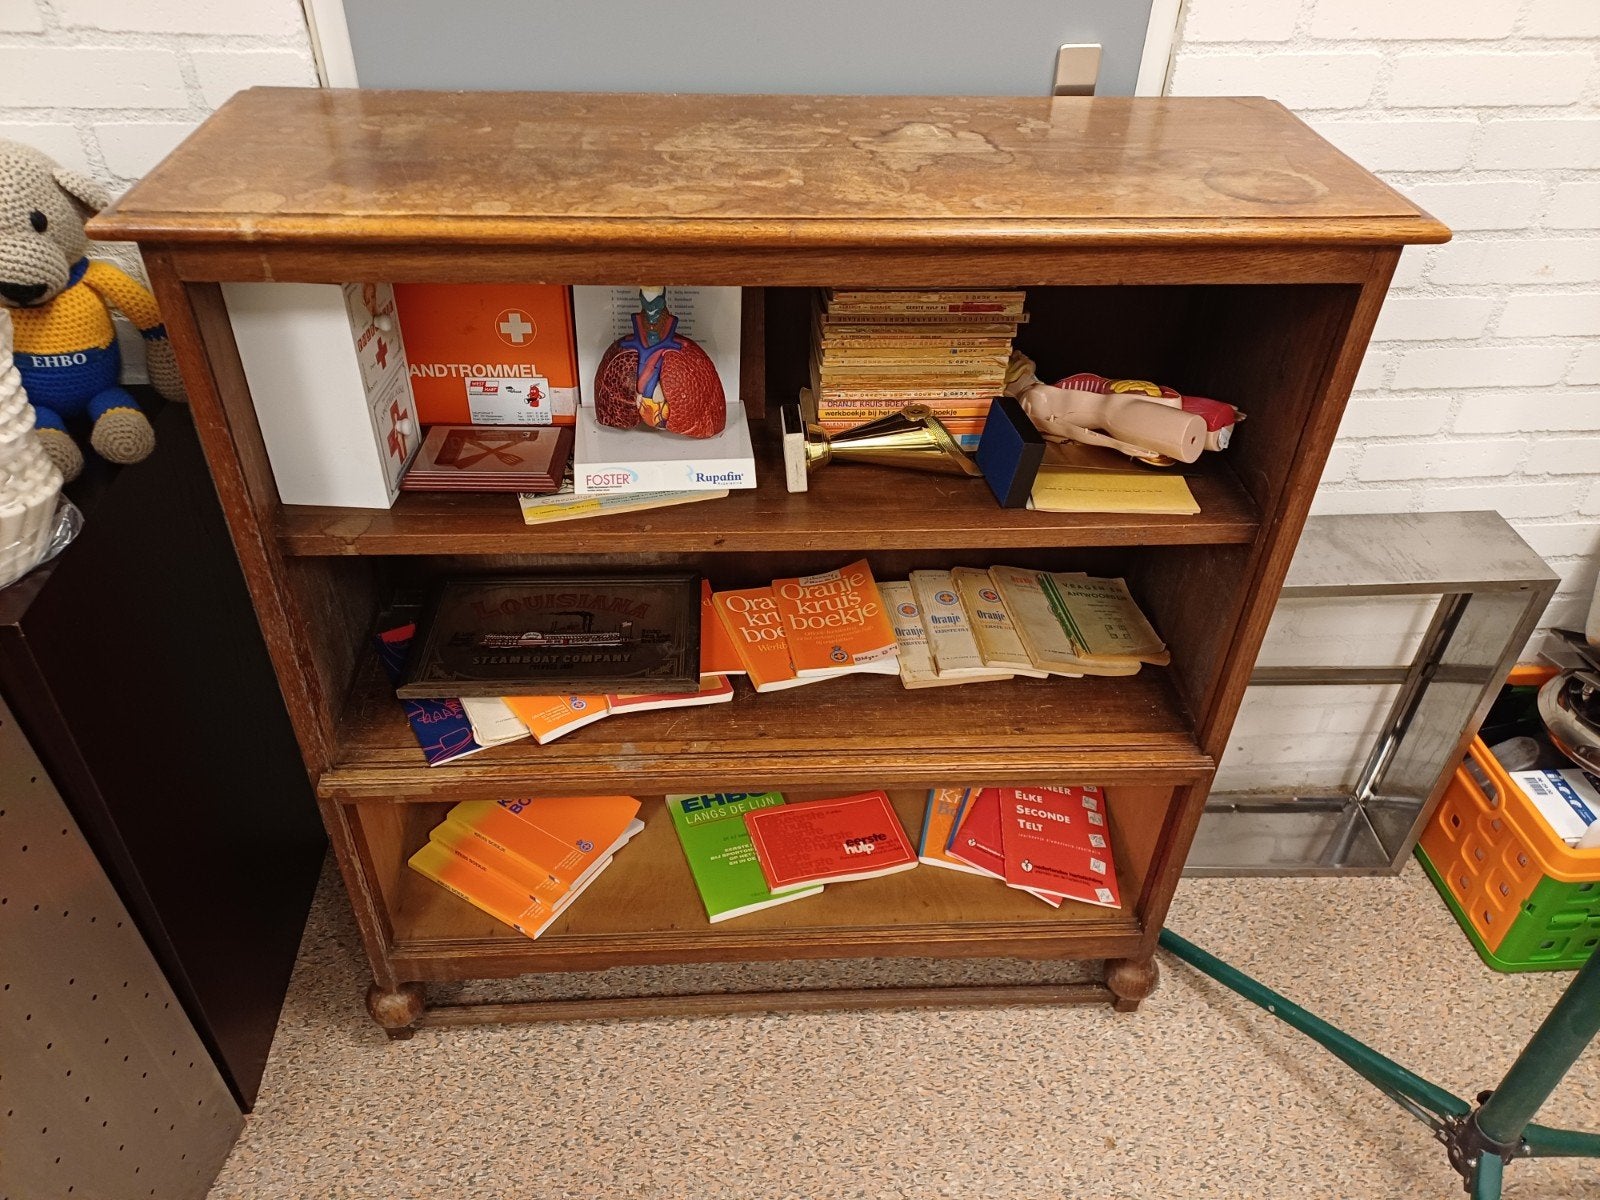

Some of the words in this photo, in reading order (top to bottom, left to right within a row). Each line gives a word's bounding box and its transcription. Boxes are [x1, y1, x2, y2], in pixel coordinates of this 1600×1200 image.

[31, 353, 88, 368] EHBO
[410, 364, 544, 378] ANDTROMMEL
[825, 409, 867, 418] werkboekje
[867, 409, 878, 417] bij
[586, 473, 631, 486] FOSTER
[696, 471, 742, 485] Rupafin
[780, 572, 867, 602] Oranje
[475, 592, 652, 620] LOUISIANA
[725, 595, 777, 614] Ora
[794, 590, 862, 616] kruis
[788, 601, 880, 631] boekje
[931, 613, 961, 625] Oranje
[976, 610, 1005, 622] Oranje
[739, 625, 787, 644] boe
[895, 625, 924, 637] Oranje
[757, 642, 789, 653] Werkb
[471, 654, 561, 666] STEAMBOAT
[562, 653, 631, 664] COMPANY
[939, 788, 963, 804] Kr
[1015, 790, 1043, 804] ELKE
[685, 808, 727, 825] LANGS
[729, 803, 747, 814] DE
[749, 796, 775, 810] LIJN
[1016, 804, 1071, 824] SECONDE
[1017, 818, 1043, 832] TELT
[845, 832, 888, 846] eerste
[843, 841, 875, 855] hulp
